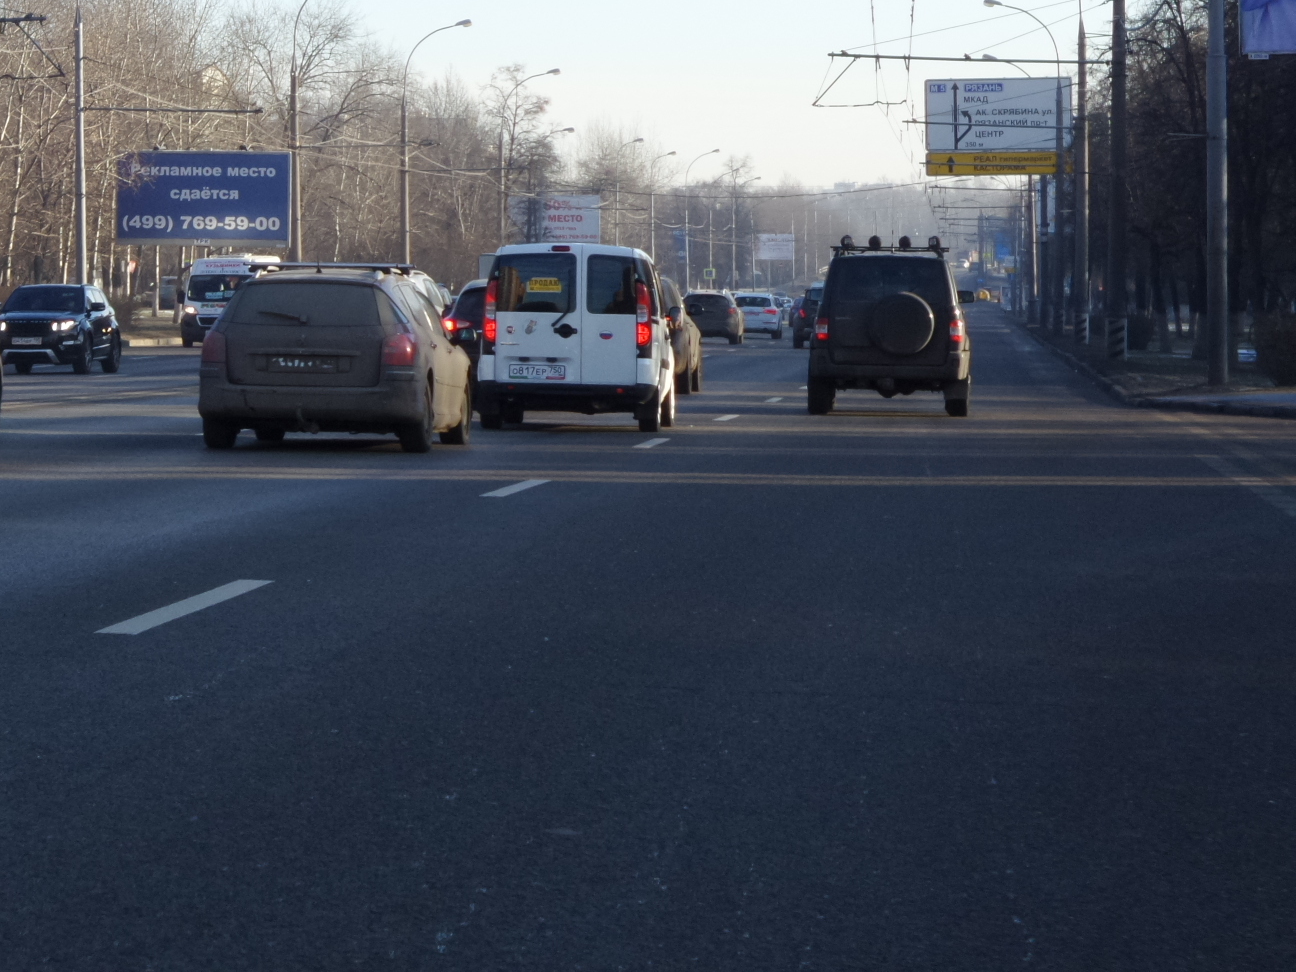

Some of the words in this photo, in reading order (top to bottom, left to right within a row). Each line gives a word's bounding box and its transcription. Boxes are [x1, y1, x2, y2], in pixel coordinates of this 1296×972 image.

[965, 84, 1002, 92] РЯЗАНЬ
[963, 96, 989, 104] МКАД
[991, 108, 1039, 116] СКРЯБИНА
[975, 130, 1004, 138] ЦЕНТР
[130, 164, 222, 177] Рекламное
[227, 166, 276, 177] место
[169, 186, 239, 202] сдаётся
[547, 214, 583, 223] МЕСТО
[122, 215, 174, 232] (499)
[180, 215, 281, 231] 769-59-00
